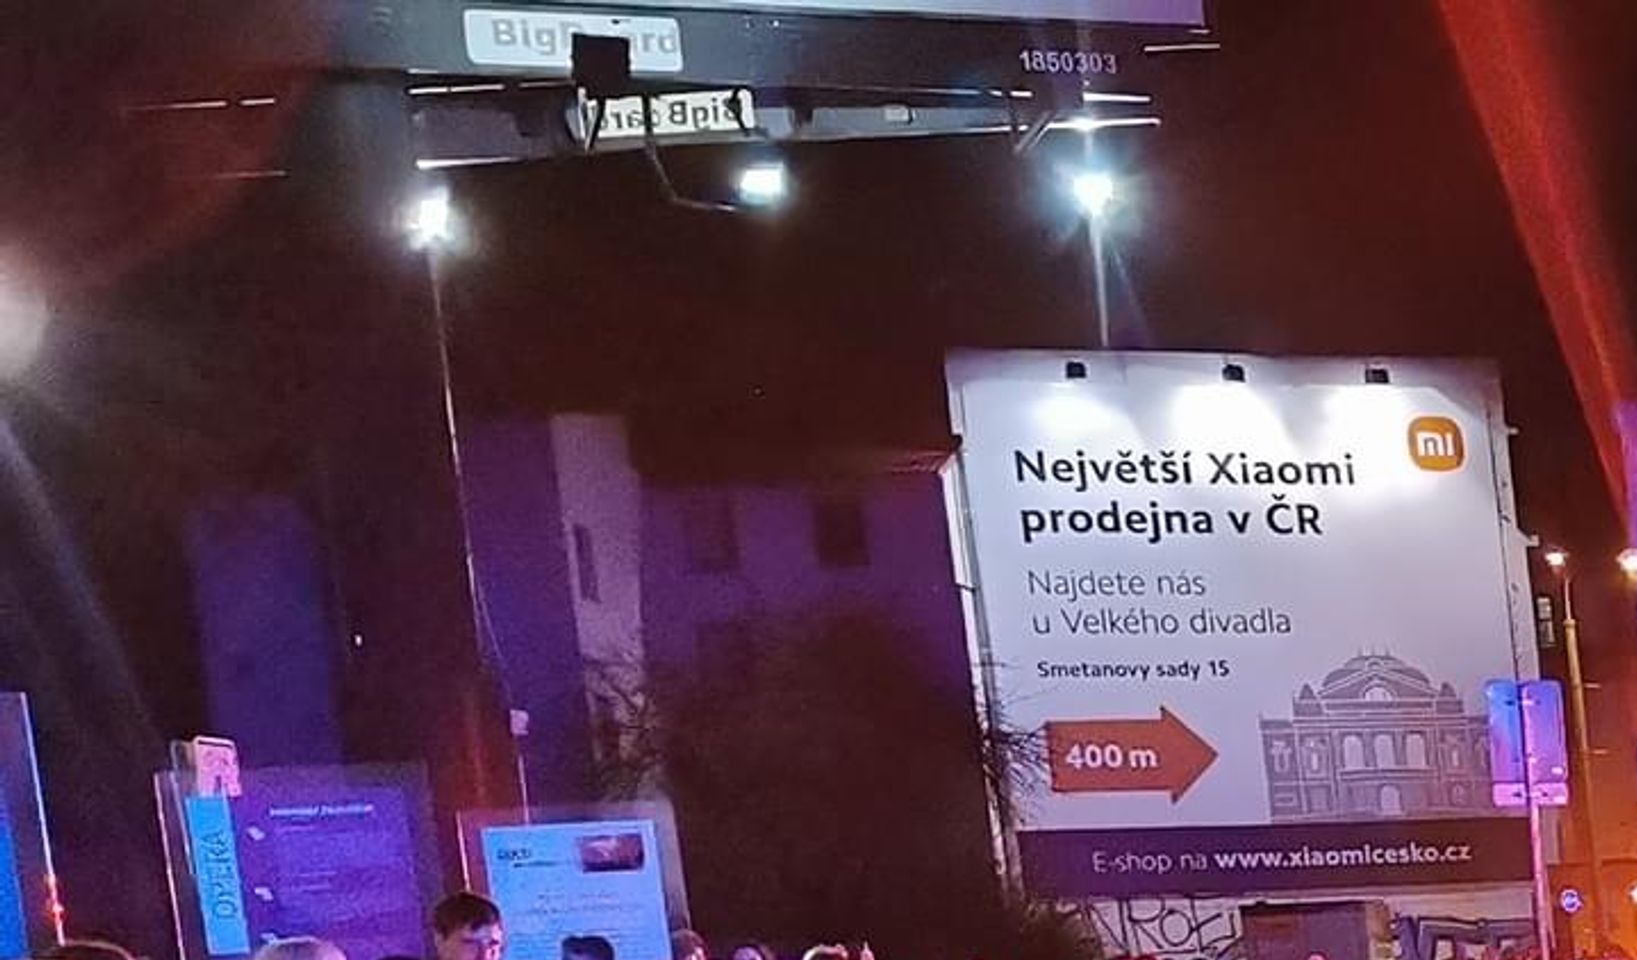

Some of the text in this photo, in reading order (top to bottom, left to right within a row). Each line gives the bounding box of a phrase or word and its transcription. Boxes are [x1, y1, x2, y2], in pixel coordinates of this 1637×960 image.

[491, 18, 678, 55] Bigrd
[1019, 50, 1117, 75] 1850303
[1014, 449, 1356, 492] Největší Xiaomi
[1021, 494, 1323, 544] prodejna v ČR
[1028, 569, 1206, 602] Najdete nás
[1033, 607, 1292, 636] u Velkého divadla
[1037, 659, 1230, 681] Smetanovy sady 15
[1066, 743, 1159, 770] 400 m
[1091, 841, 1472, 875] E-shop na www.xiaomicesko.cz
